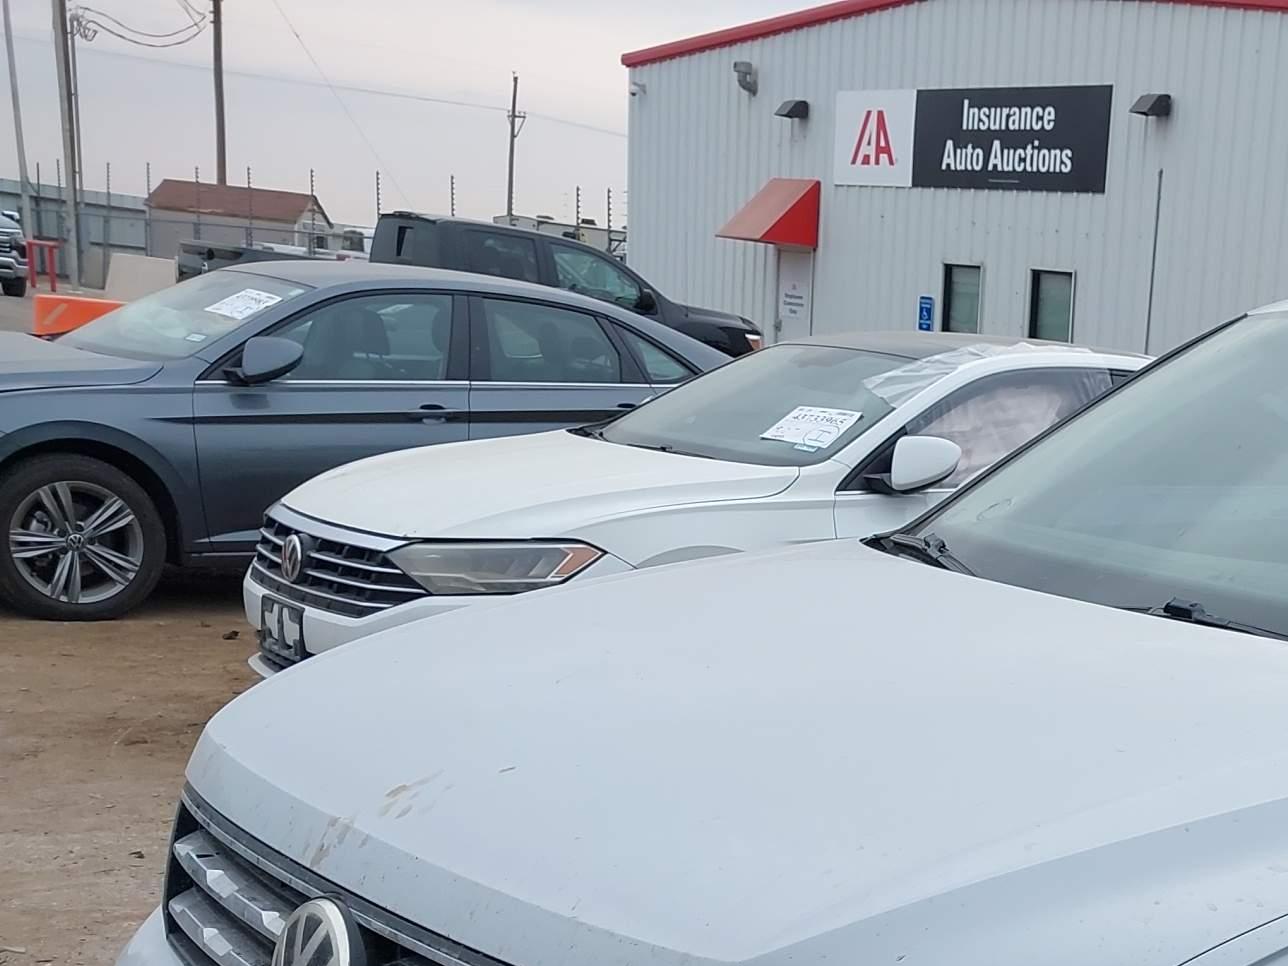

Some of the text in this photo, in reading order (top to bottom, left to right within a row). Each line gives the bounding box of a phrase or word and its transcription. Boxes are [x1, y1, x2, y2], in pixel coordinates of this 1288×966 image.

[962, 99, 1055, 131] Insurance
[941, 139, 1072, 173] Auto Auctions
